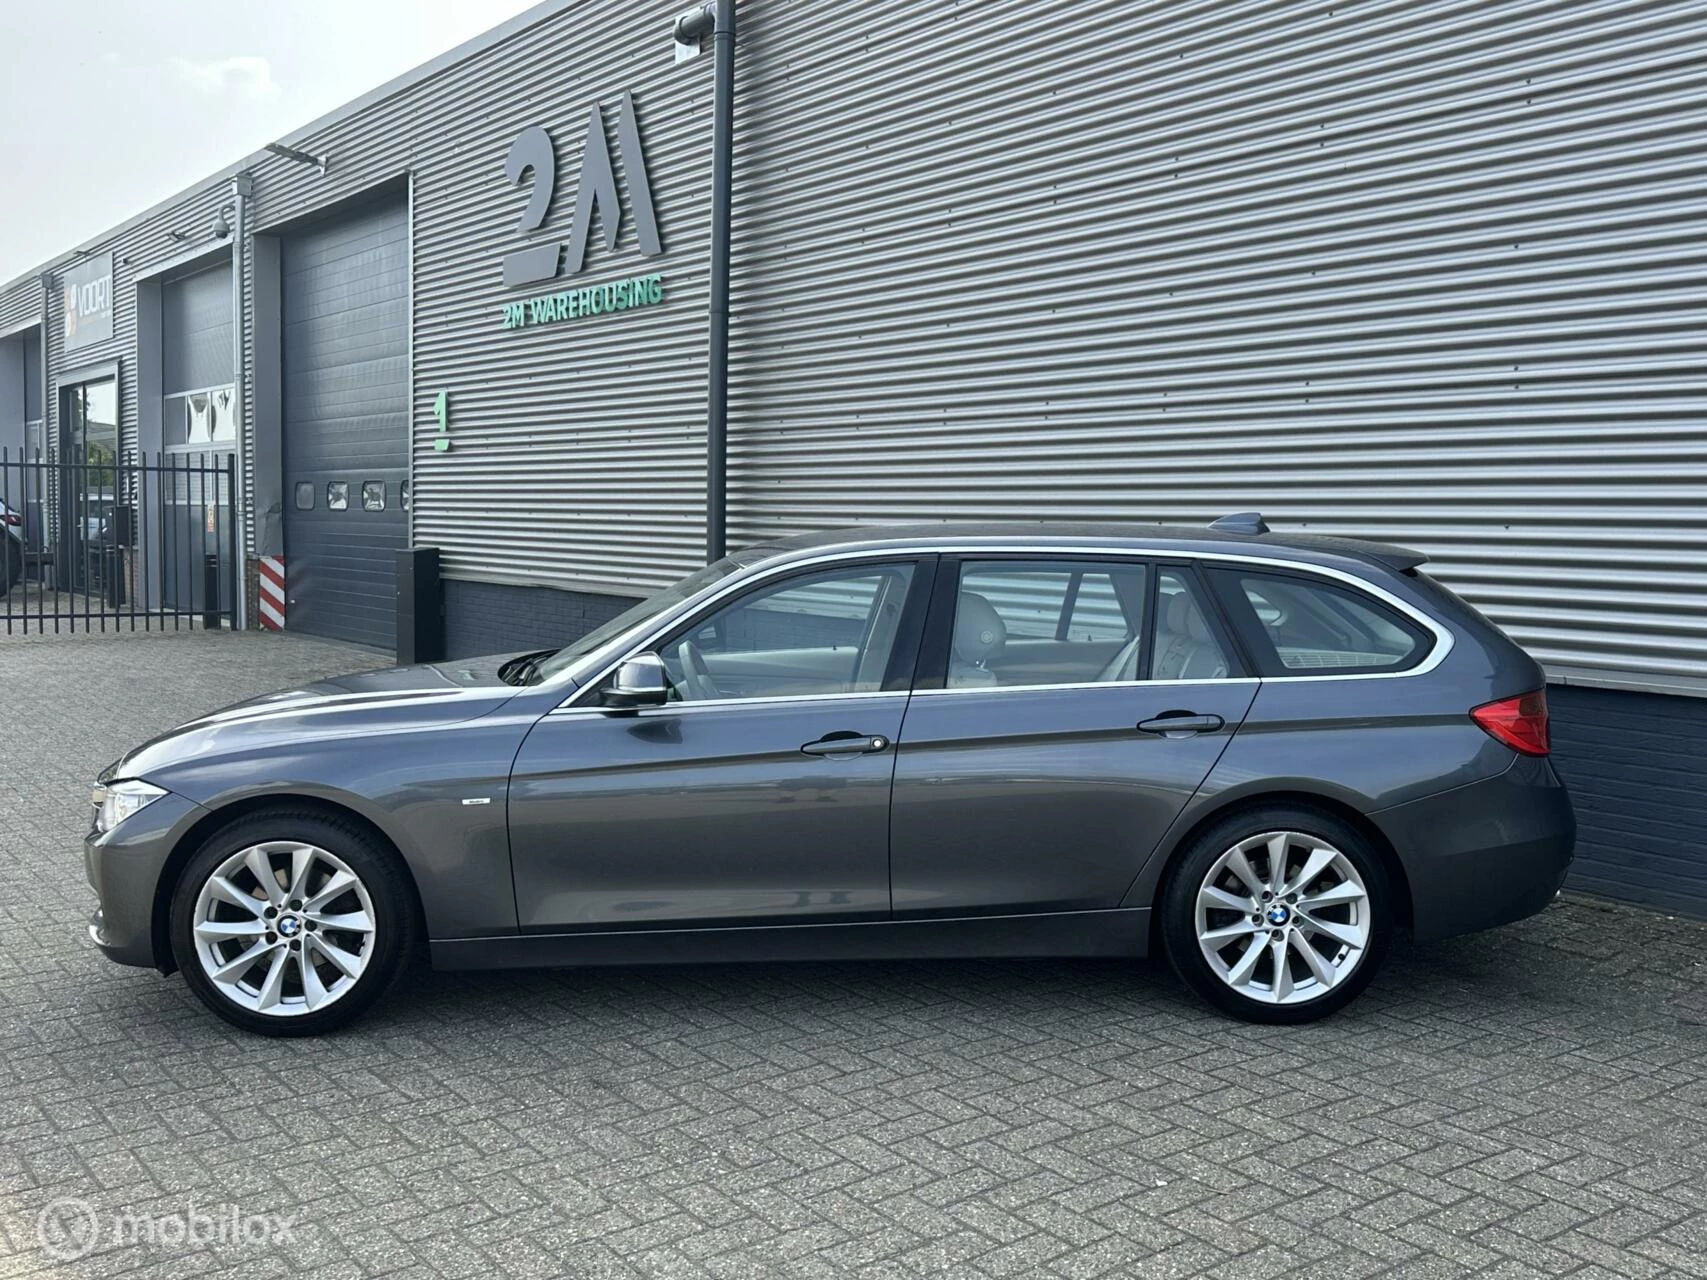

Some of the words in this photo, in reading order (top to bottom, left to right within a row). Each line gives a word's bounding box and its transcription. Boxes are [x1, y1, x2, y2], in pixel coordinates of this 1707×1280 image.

[503, 87, 664, 288] 2M
[77, 274, 113, 318] VOORT
[502, 302, 525, 329] 2M
[530, 273, 663, 325] WAREHOUSING
